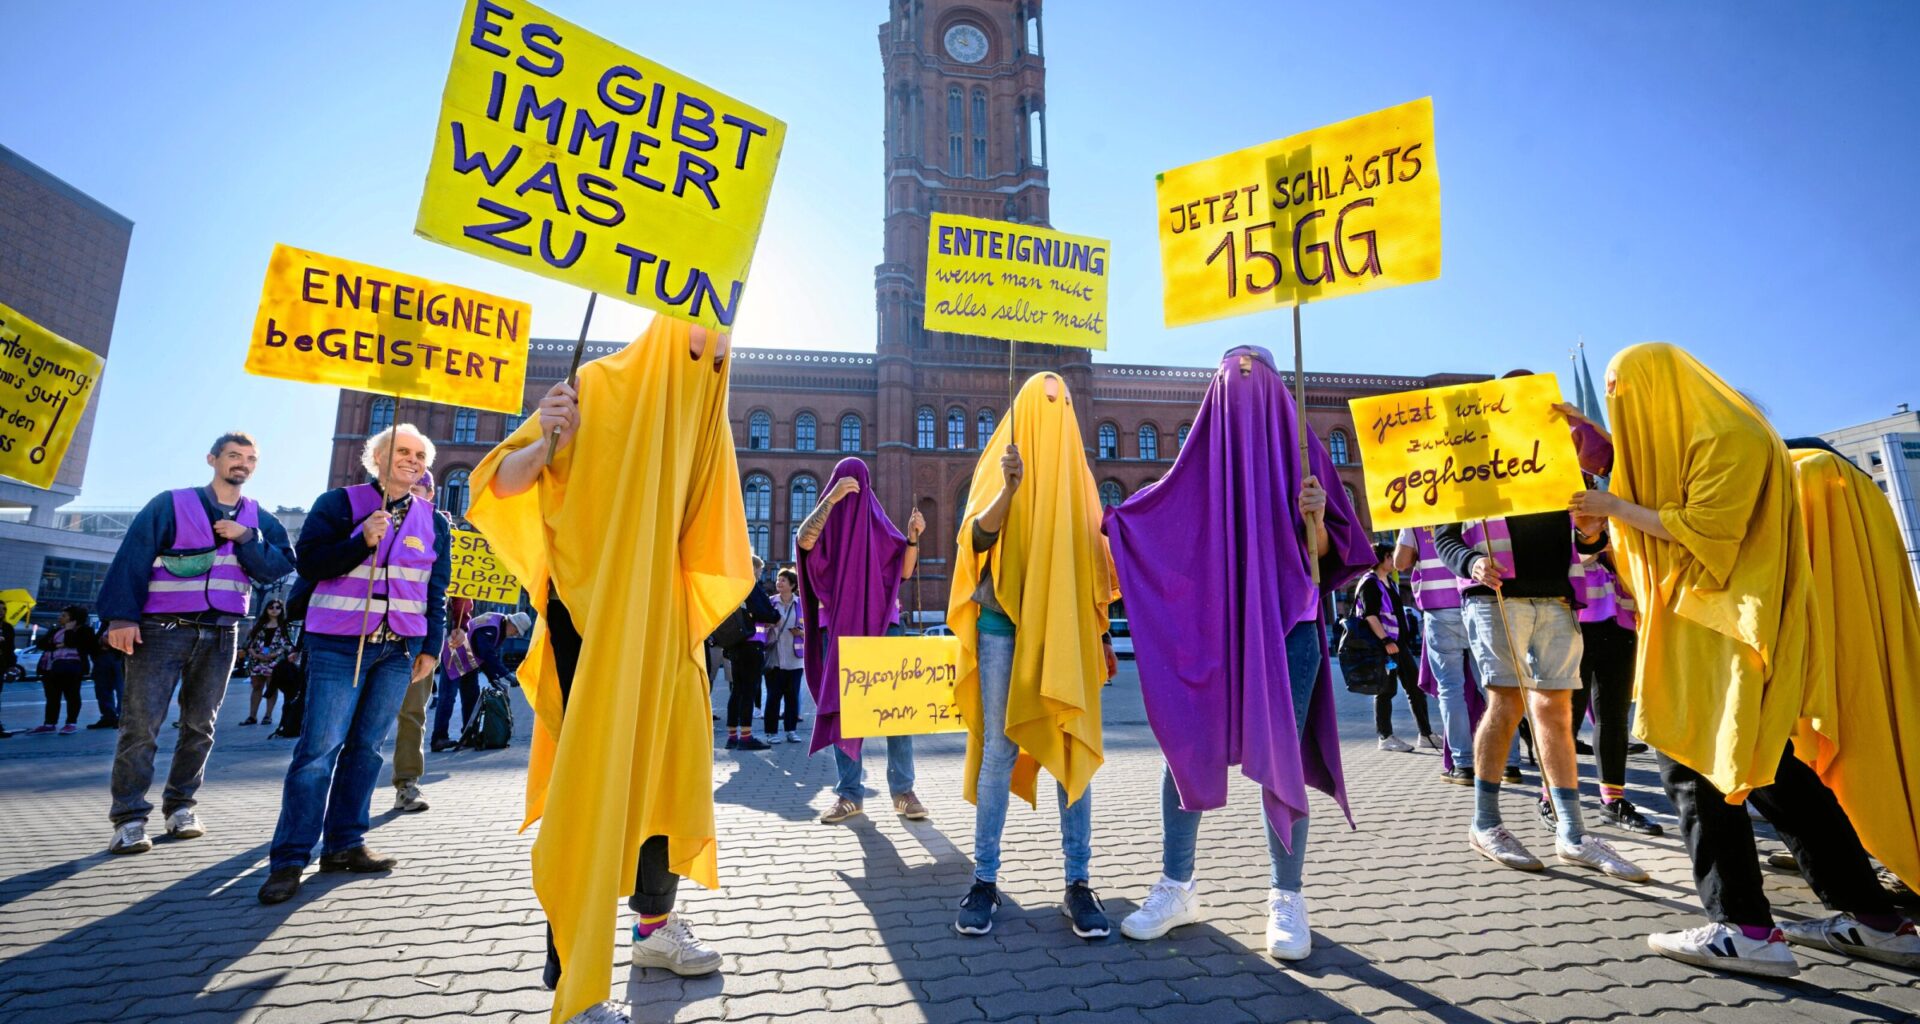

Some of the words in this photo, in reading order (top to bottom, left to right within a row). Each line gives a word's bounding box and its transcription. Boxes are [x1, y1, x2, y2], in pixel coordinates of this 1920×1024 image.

[471, 0, 564, 77] ES
[597, 65, 767, 170] GIBT
[486, 71, 720, 210] IMMER
[451, 121, 625, 227] WAS
[1170, 184, 1259, 234] JETZT
[1272, 143, 1422, 210] SCHLÄGTS
[463, 197, 587, 269] ZU
[615, 243, 743, 326] TUN
[938, 225, 1106, 276] ENTEIGNUNG
[302, 267, 519, 342] ENTEIGNEN
[935, 268, 994, 287] wenn
[1001, 271, 1043, 290] man
[1049, 277, 1094, 302] nicht
[934, 293, 986, 317] alles
[991, 298, 1048, 324] selber
[1053, 311, 1104, 335] macht
[0, 320, 92, 396] nteignung:
[266, 318, 509, 383] beGEISTERT
[0, 367, 26, 389] nn's
[0, 404, 35, 432] rden
[1373, 397, 1436, 444] jetzt
[1455, 393, 1511, 418] wird
[1385, 440, 1546, 513] geghosted
[445, 581, 513, 600] aCHT
[451, 568, 517, 588] LBeR
[841, 657, 957, 697] ückgeghosted
[927, 703, 963, 725] tzt
